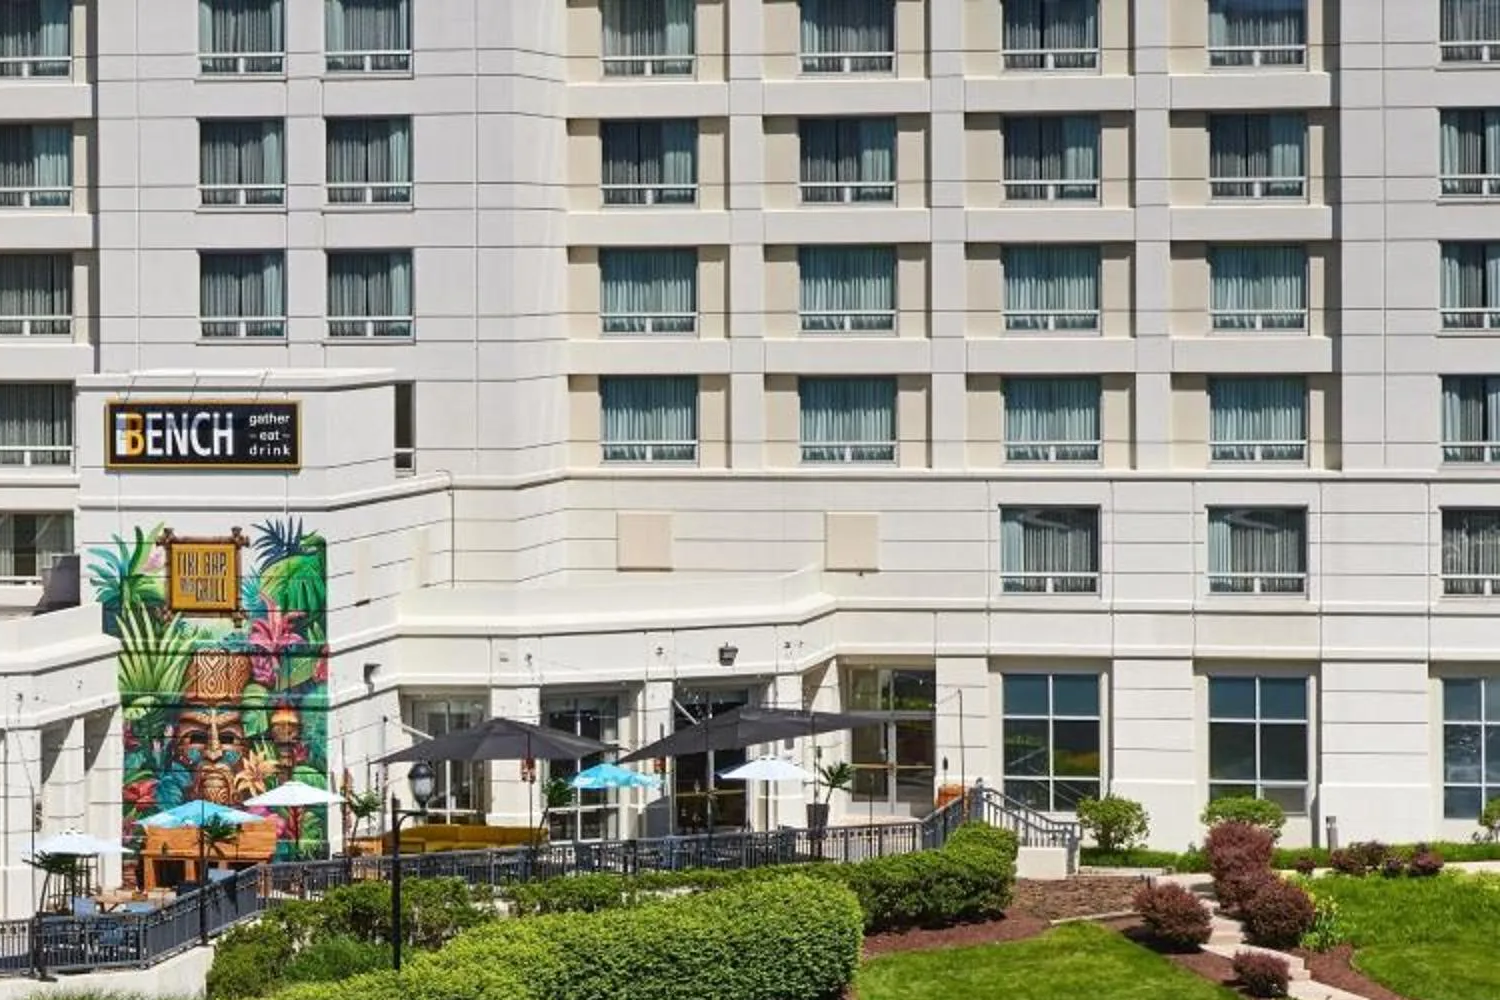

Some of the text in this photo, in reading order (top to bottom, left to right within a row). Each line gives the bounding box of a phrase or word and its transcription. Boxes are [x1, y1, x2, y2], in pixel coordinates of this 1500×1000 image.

[249, 413, 290, 426] gather
[115, 411, 233, 456] BENCH
[259, 430, 280, 441] eat
[249, 444, 290, 456] drink
[177, 552, 227, 576] TIKI BAR
